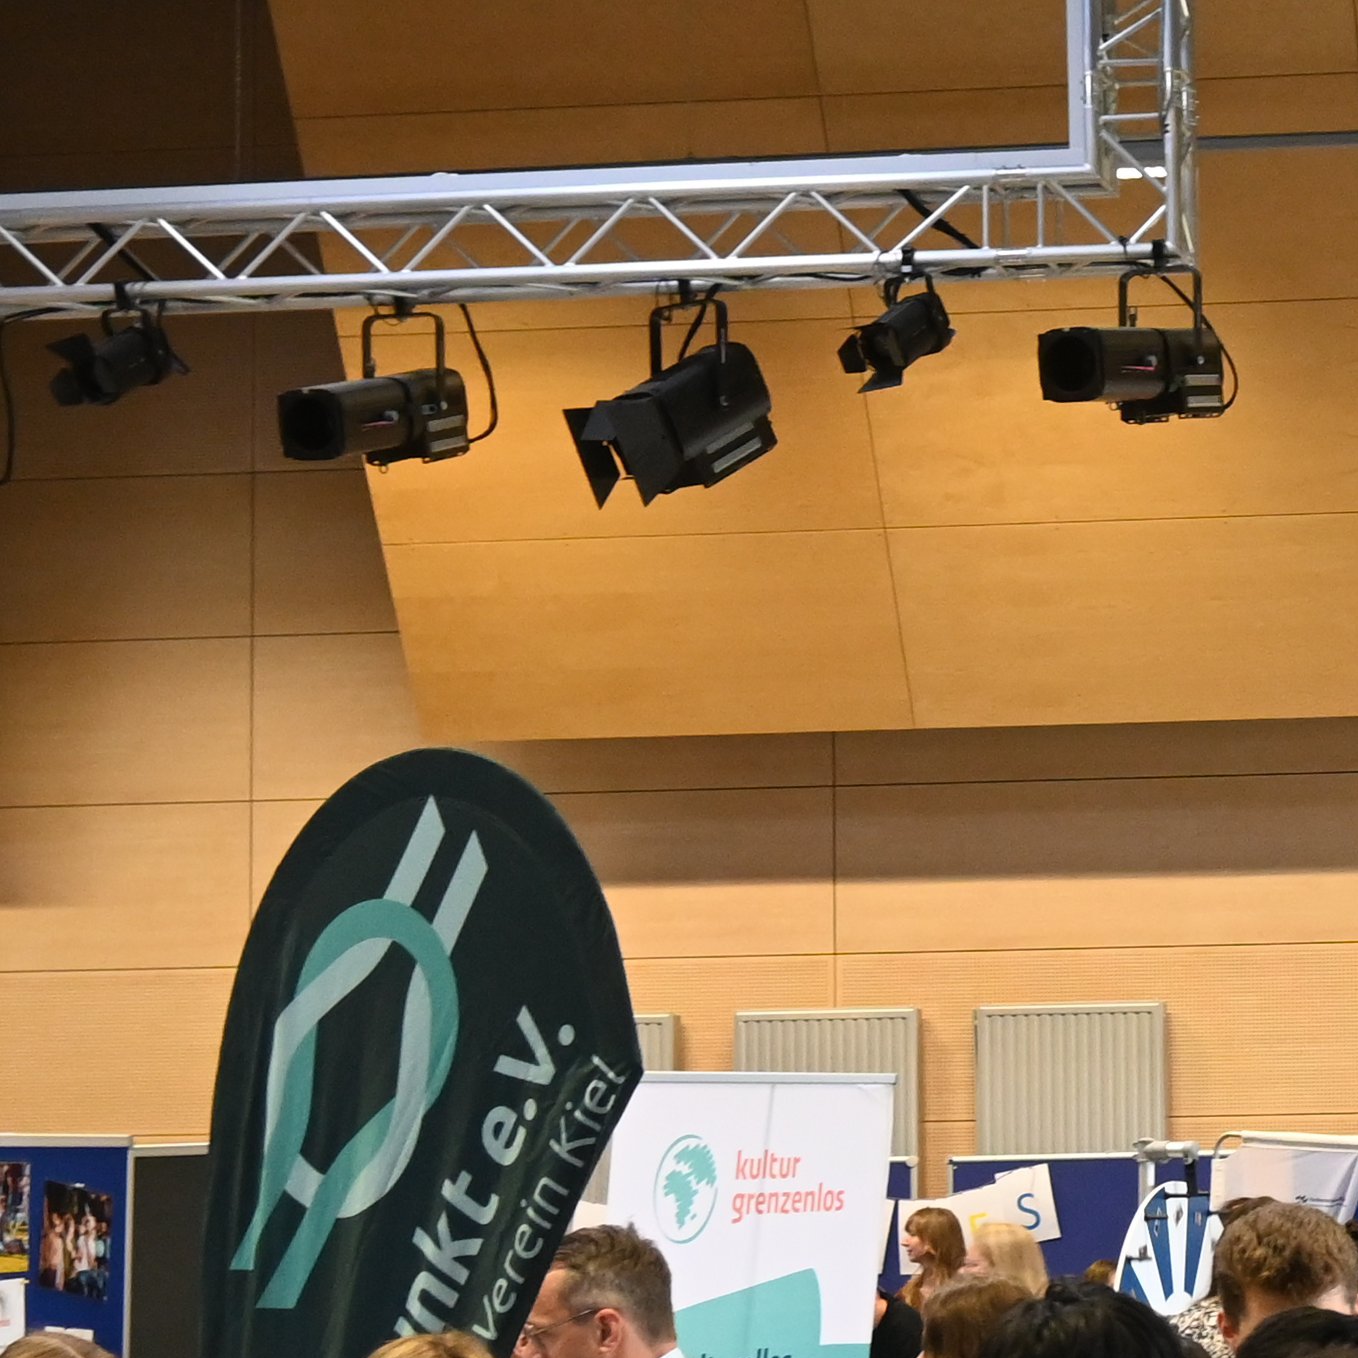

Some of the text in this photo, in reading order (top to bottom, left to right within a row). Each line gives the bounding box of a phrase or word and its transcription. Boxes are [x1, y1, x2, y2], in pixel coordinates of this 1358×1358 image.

[549, 1054, 627, 1168] Kiel
[394, 1005, 575, 1337] nkt e.V.
[731, 1182, 845, 1224] grenzenlos
[734, 1149, 801, 1180] kultur
